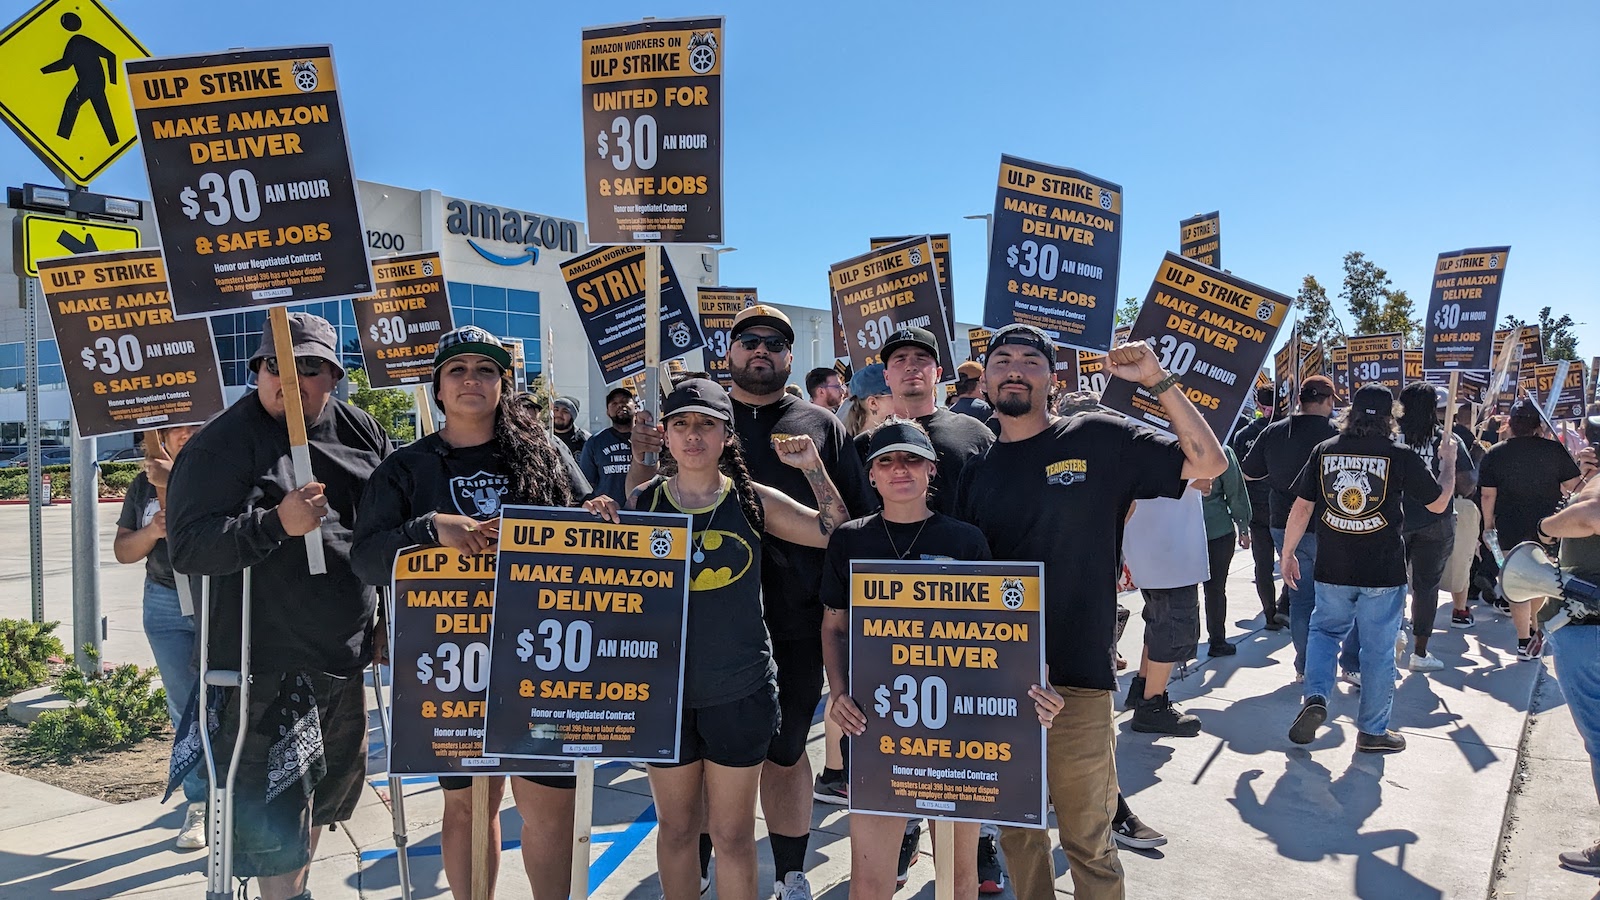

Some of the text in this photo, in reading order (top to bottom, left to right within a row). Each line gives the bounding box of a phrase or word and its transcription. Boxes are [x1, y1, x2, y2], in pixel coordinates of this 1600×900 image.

[590, 37, 681, 56] AMAZON WORKERS ON
[590, 52, 680, 78] ULP STRIKE
[143, 68, 283, 101] ULP STRIKE
[592, 86, 709, 112] UNITED FOR
[151, 105, 329, 139] MAKE AMAZON
[189, 132, 304, 164] DELIVER
[597, 114, 708, 171] $30 AN HOUR
[180, 169, 331, 226] $30 AN HOUR
[599, 175, 708, 197] & SAFE JOBS
[1007, 169, 1093, 201] ULP STRIKE
[446, 201, 578, 253] amazon
[1003, 197, 1114, 233] MAKE AMAZON
[195, 223, 332, 255] & SAFE JOBS
[365, 229, 405, 251] 1200
[1021, 218, 1095, 247] DELIVER
[1182, 223, 1210, 241] ULP STRIKE
[935, 242, 944, 250] ON
[1197, 240, 1218, 255] AMAZON
[214, 252, 322, 274] Honor our Negotiated Contract
[377, 263, 416, 280] STRIKE
[569, 245, 642, 277] AMAZON WORKERS
[839, 254, 904, 285] ULP STRIKE
[1006, 240, 1103, 281] $30 AN HOUR
[1439, 256, 1485, 271] ULP STRIKE
[51, 263, 158, 288] ULP STRIKE
[576, 260, 671, 314] STRIE
[1436, 274, 1498, 289] MAKE AMAZON
[389, 282, 440, 299] AMAZON
[843, 271, 929, 306] MAKE AMAZON
[1007, 279, 1097, 309] & SAFE JOBS
[1165, 266, 1254, 311] ULP STRIKE
[1442, 287, 1483, 300] DELIVER
[58, 297, 112, 315] MAKE
[373, 296, 427, 315] DELIVER
[701, 301, 742, 312] ULP STRIKE
[860, 290, 915, 317] DELIVER
[87, 308, 174, 332] DELIVER
[1154, 291, 1267, 344] MAKE AMAZON
[1434, 303, 1487, 330] $30 HOUR
[369, 316, 441, 346] $30 AN HOUR
[1165, 314, 1239, 354] DELIVER
[1439, 332, 1481, 343] SAFE JOBS
[80, 334, 196, 375] $30 AN HOUR
[376, 349, 386, 360] &
[386, 345, 412, 359] SAFE
[1350, 342, 1388, 353] ULP STRIKE
[1352, 352, 1399, 363] UNITED FOR
[93, 370, 198, 395] & SAFE JOBS
[1192, 359, 1237, 387] AN HOUR
[1539, 372, 1581, 391] STKE
[610, 443, 620, 452] MY
[613, 454, 627, 462] WAS
[1045, 459, 1087, 477] TEAMSTERS
[1323, 456, 1386, 481] TEAMSTER
[457, 476, 509, 488] RAIDERS
[1326, 512, 1384, 531] THUNDER
[513, 525, 639, 551] ULP STRIKE
[407, 553, 448, 573] ULP
[509, 563, 674, 589] MAKE AMAZON
[407, 590, 468, 608] MAKE
[537, 588, 644, 614] DELIVER
[863, 580, 990, 603] ULP STRIKE
[863, 618, 1029, 643] MAKE AMAZON
[515, 618, 659, 673] $30 AN HOUR
[891, 644, 999, 669] DELIVER
[416, 642, 490, 693] $30
[518, 678, 651, 701] & SAFE JOBS
[874, 674, 1018, 730] $30 AN HOUR
[530, 708, 636, 722] Honor our Negotiated Contract
[879, 735, 1012, 762] & SAFE JOBS
[892, 765, 998, 781] Honor our Negotiated Contract
[891, 780, 918, 789] Teamsters
[918, 781, 933, 790] Local
[944, 783, 954, 792] has
[954, 784, 962, 792] no
[962, 784, 977, 793] labor
[978, 786, 999, 796] dispute
[894, 788, 996, 802] with any employer other than Amazon
